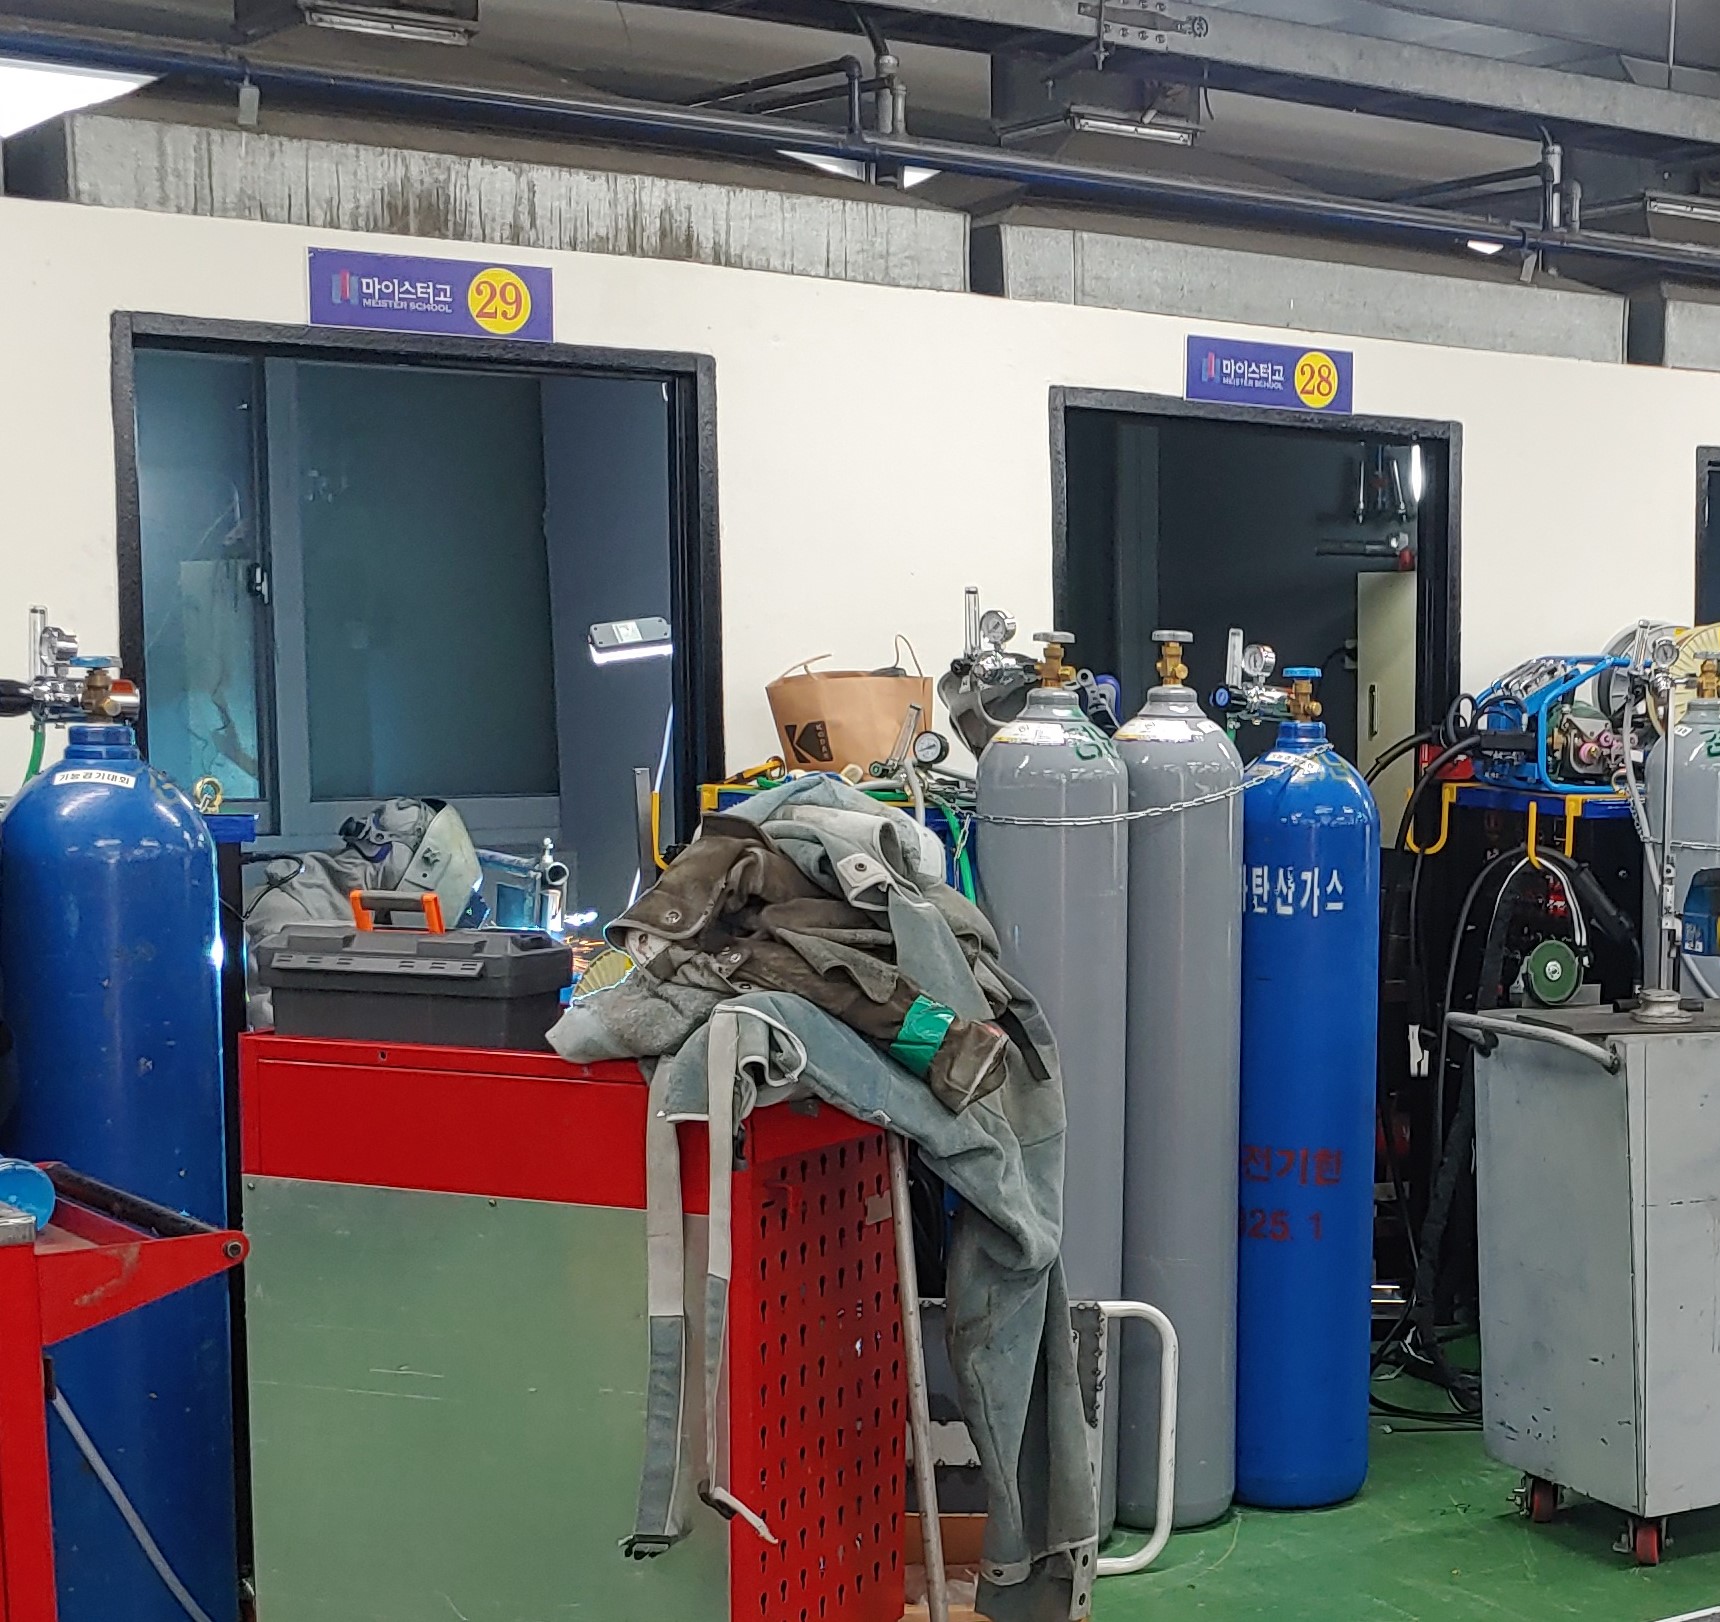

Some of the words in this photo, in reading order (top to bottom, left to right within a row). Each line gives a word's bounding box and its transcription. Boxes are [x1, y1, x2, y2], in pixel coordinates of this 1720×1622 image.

[361, 277, 453, 304] 마이스터고
[475, 280, 523, 321] 29
[362, 298, 408, 309] MEISTER
[409, 301, 452, 313] SCHOOL
[1222, 359, 1285, 383] 마이스터고
[1300, 363, 1333, 397] 28
